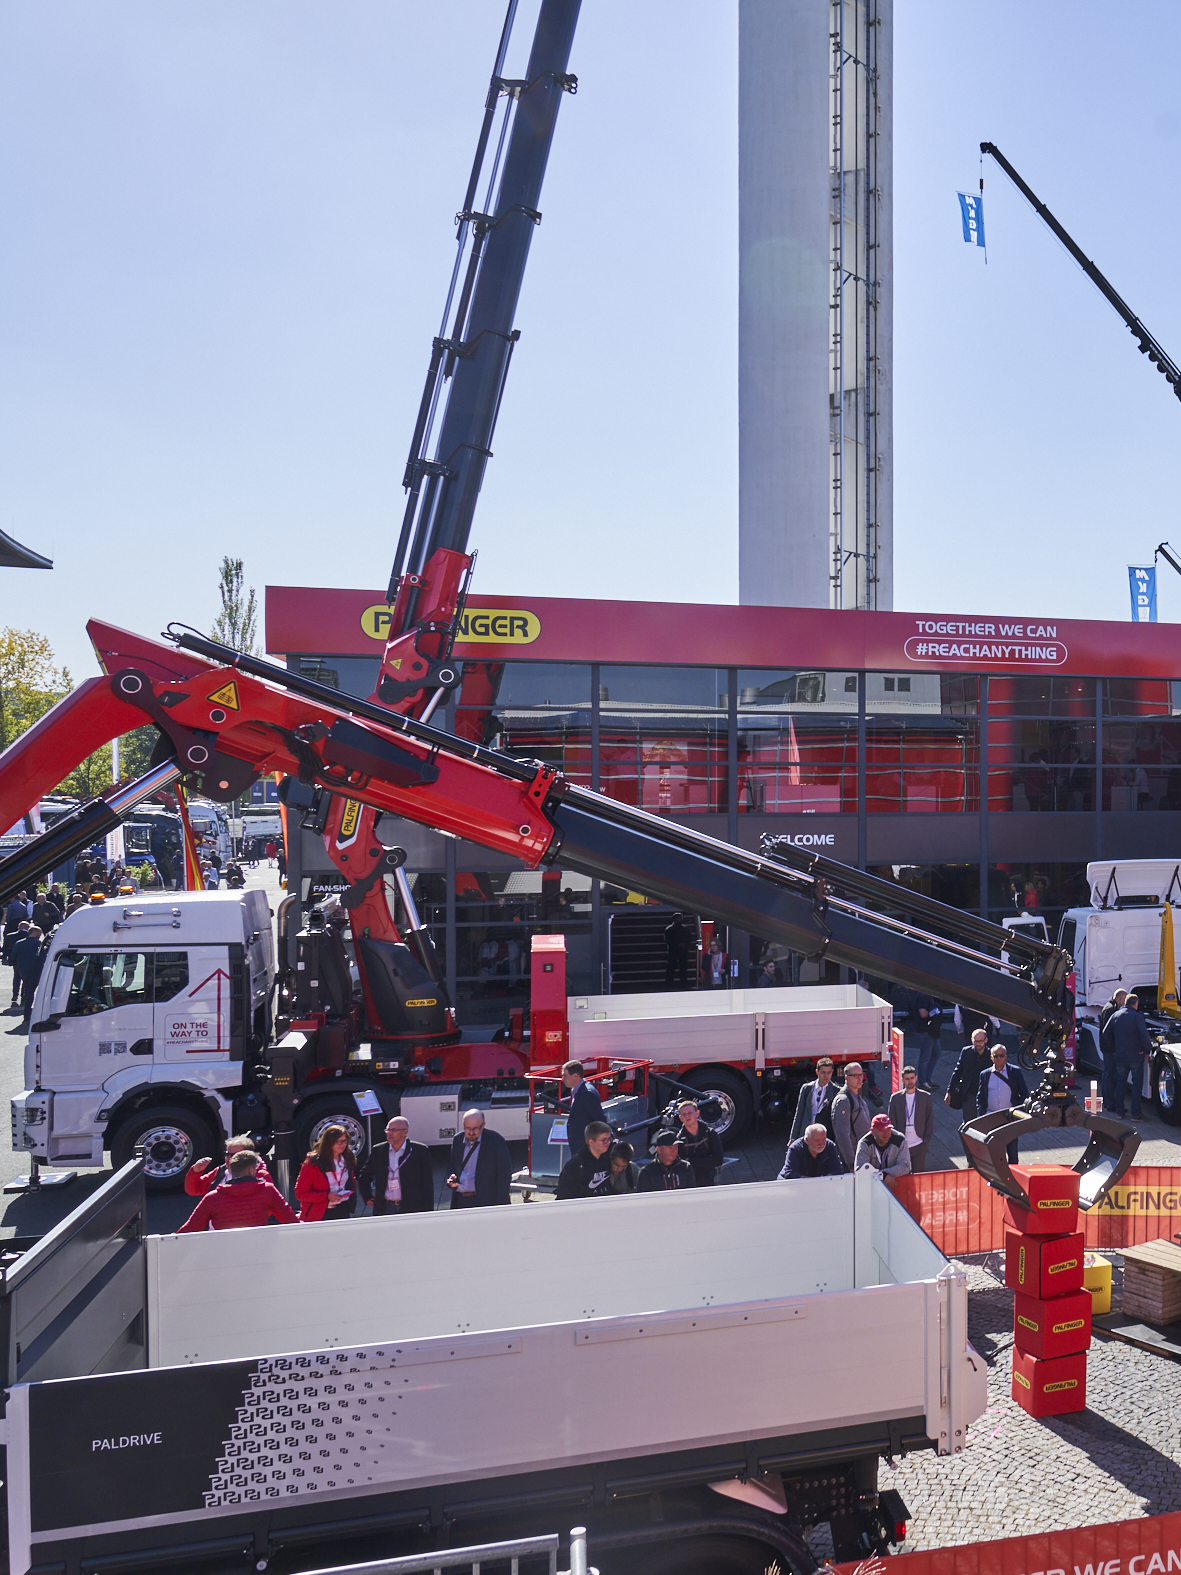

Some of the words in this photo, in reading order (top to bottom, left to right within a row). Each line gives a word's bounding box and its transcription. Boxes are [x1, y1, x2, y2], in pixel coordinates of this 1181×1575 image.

[915, 621, 995, 636] TOGETHER
[999, 624, 1024, 637] WE
[1026, 625, 1057, 638] CAN
[916, 642, 1057, 660] #REACHANYTHING
[172, 1022, 187, 1030] ON
[189, 1021, 209, 1029] THE
[170, 1030, 193, 1038] WAY
[194, 1029, 209, 1037] TO
[1018, 1316, 1038, 1331] PALFINGER
[1054, 1320, 1083, 1332] PALFINGER
[1045, 1380, 1076, 1392] PALFINGER
[92, 1432, 163, 1451] PALDRIVE
